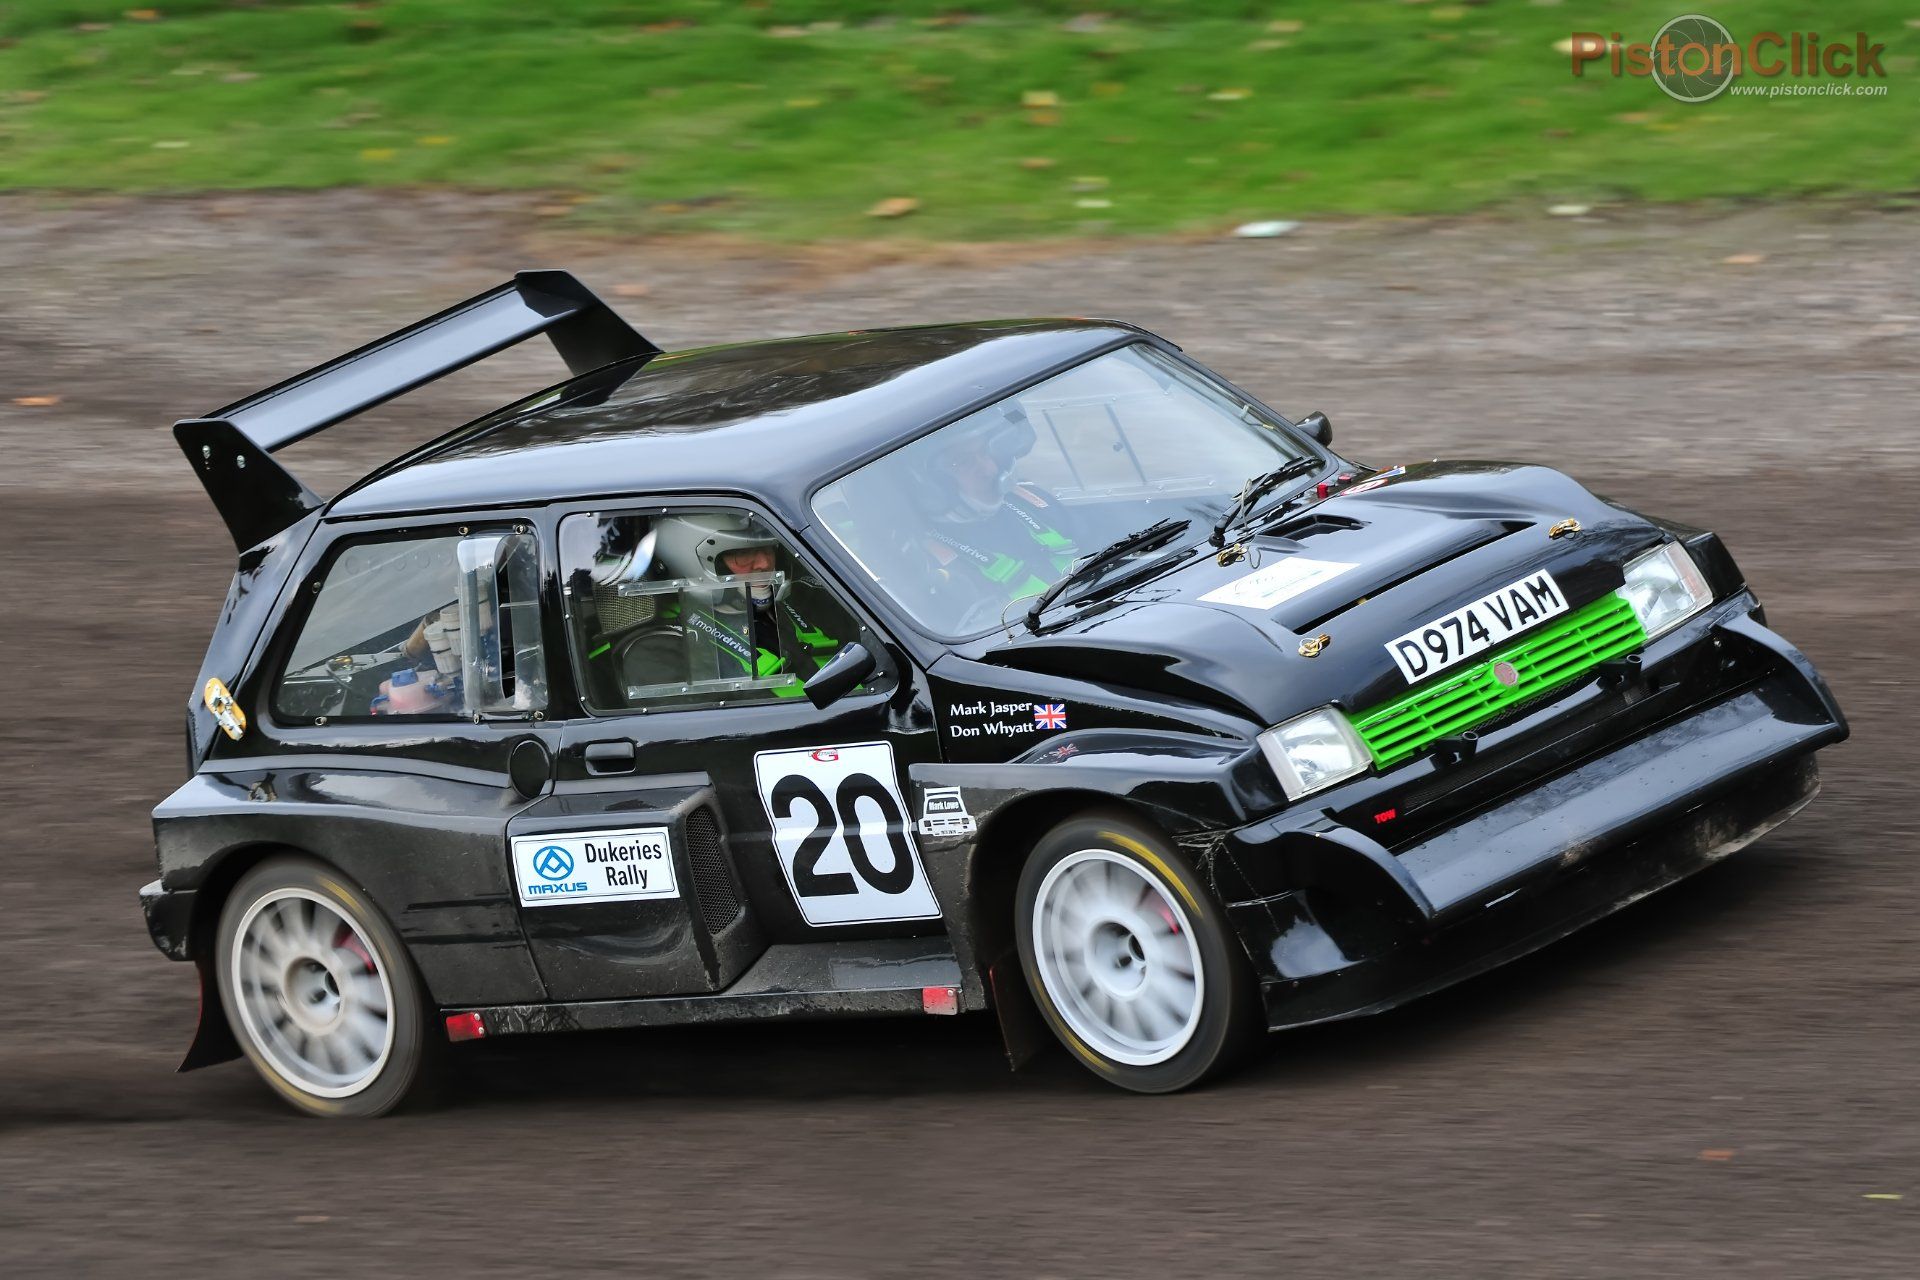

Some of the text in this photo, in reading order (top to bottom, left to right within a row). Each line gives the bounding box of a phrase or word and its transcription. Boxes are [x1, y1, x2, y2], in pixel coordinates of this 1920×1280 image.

[1395, 610, 1490, 677] D974
[1483, 576, 1560, 631] VAM
[696, 619, 752, 658] motordrive
[950, 701, 1032, 717] Mark Jasper
[950, 721, 1035, 738] Don Whyatt
[928, 801, 959, 811] Mark Lowe
[1374, 808, 1396, 824] TOW
[771, 773, 914, 897] 20
[584, 840, 662, 863] Dukeries
[605, 864, 648, 889] Rally
[528, 882, 588, 895] MAXUS
